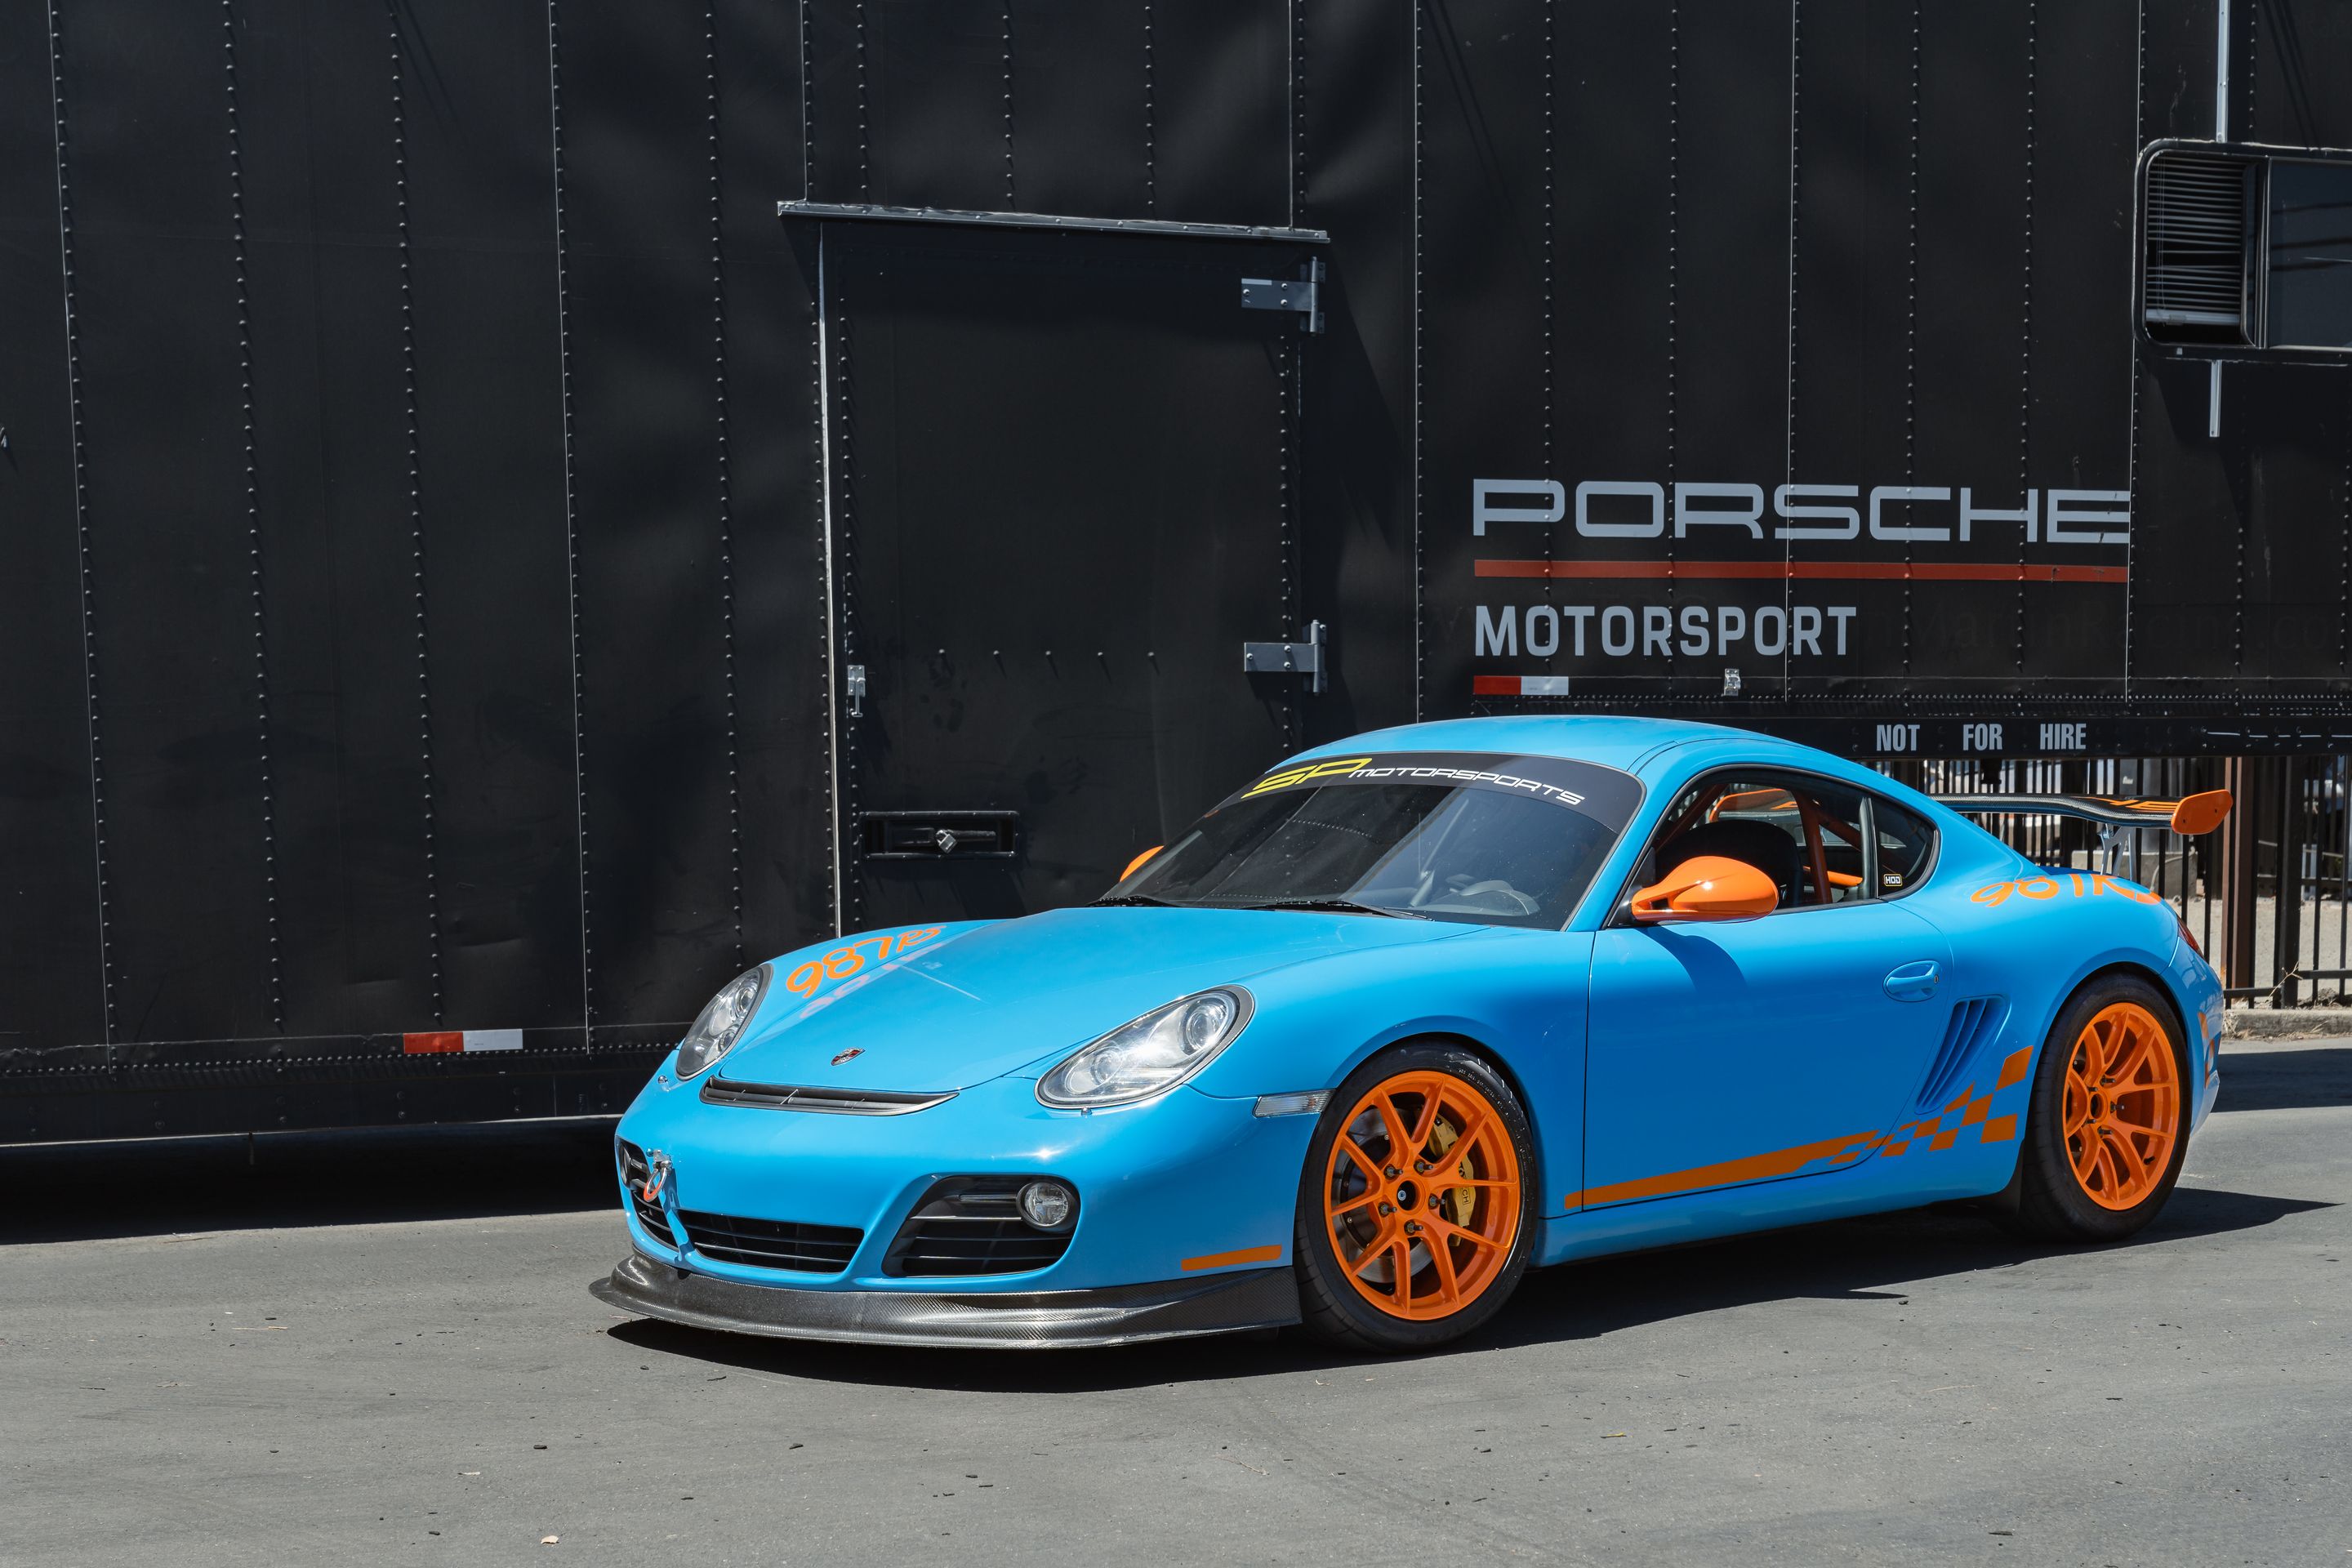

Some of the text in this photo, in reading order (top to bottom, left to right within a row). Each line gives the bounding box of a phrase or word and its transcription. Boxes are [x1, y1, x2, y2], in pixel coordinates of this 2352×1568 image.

[1473, 479, 2132, 544] PORSCHE
[1474, 605, 1857, 657] MOTORSPORT
[1876, 724, 2087, 751] NOT FOR HIRE
[1348, 766, 1585, 805] MOTORSPORTS
